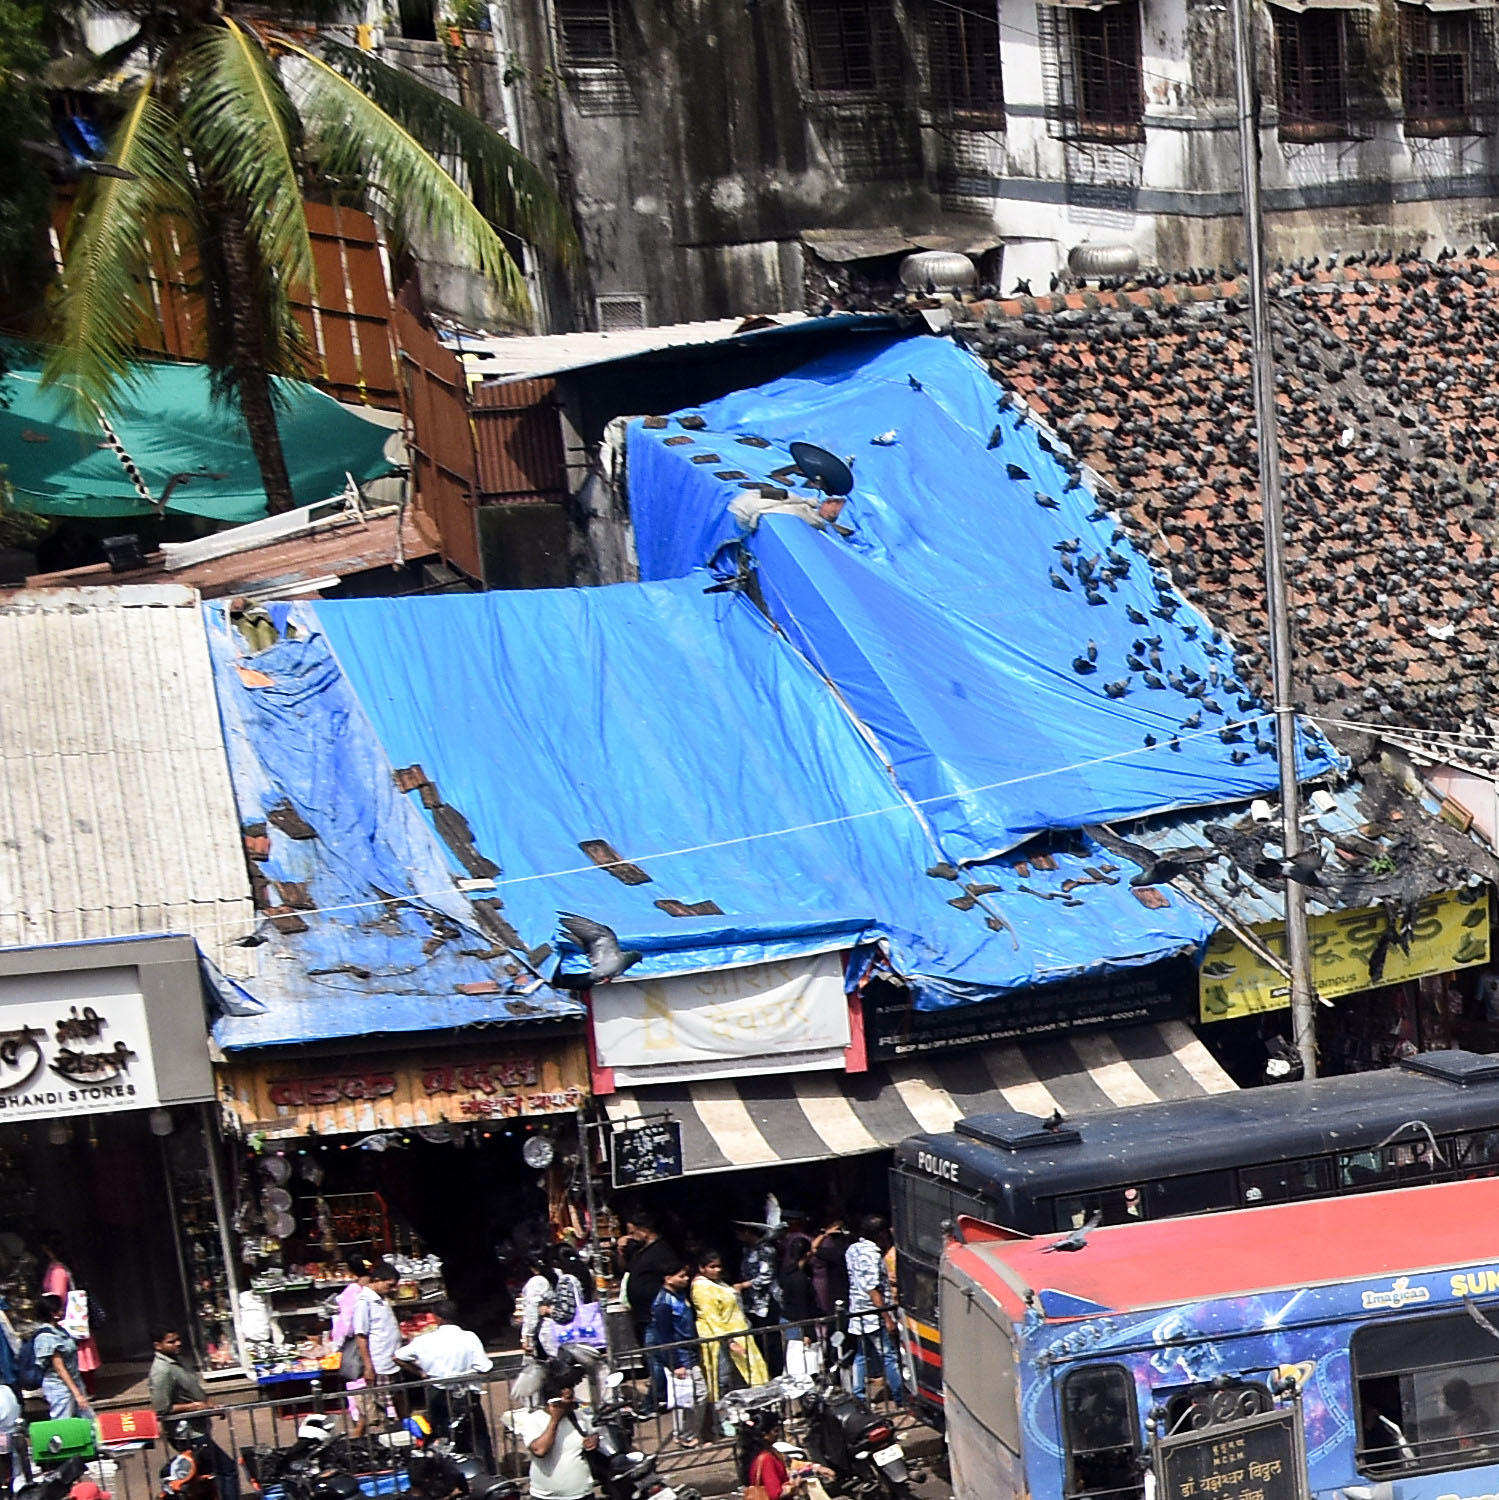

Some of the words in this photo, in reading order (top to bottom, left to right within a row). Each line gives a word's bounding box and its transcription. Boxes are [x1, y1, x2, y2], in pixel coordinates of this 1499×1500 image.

[948, 1032, 990, 1047] KABUTAR
[68, 1084, 137, 1103] STORES
[918, 1151, 959, 1183] POLICE
[1364, 1286, 1427, 1306] Imagicaa
[1199, 1469, 1245, 1493] यज्ञेश्वर
